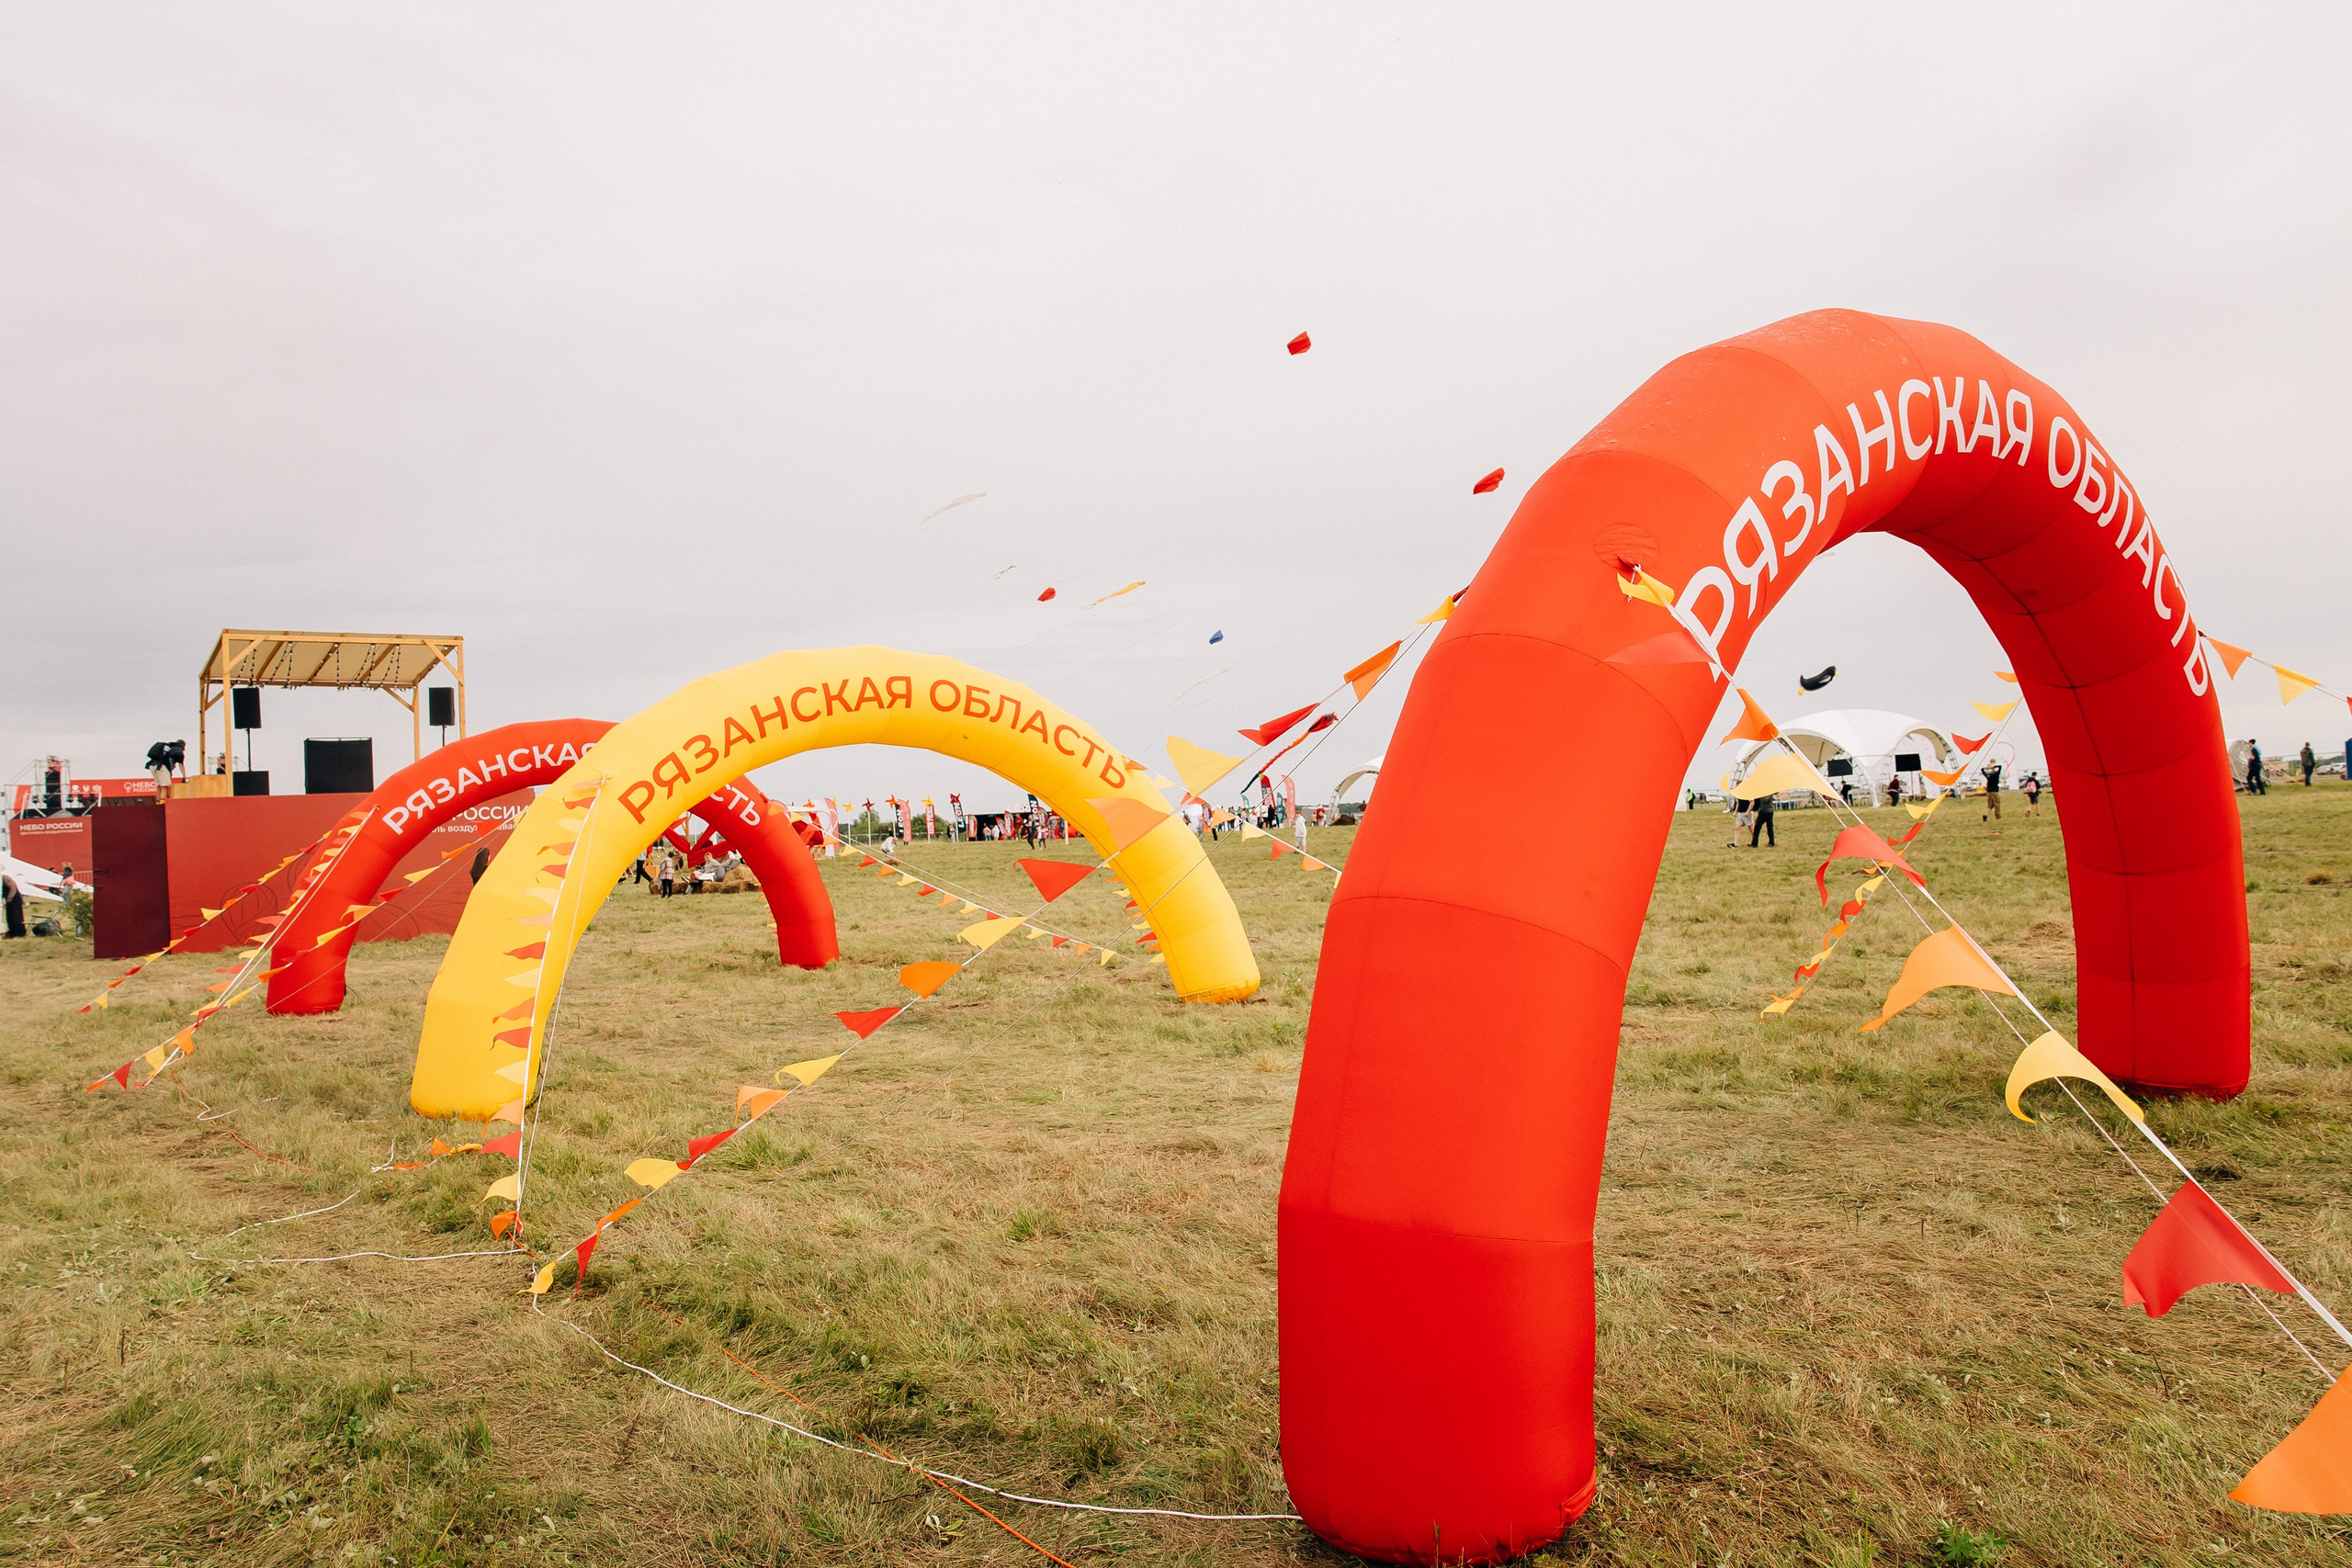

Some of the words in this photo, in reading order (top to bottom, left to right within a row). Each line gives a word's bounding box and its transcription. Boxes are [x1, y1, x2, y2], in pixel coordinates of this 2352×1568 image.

[1674, 376, 2034, 682] РЯЗАНСКАЯ
[2048, 416, 2209, 697] ОБЛАСТЬ
[20, 823, 45, 831] НЕБО
[46, 821, 83, 830] РОССИИ
[617, 676, 912, 826] РЯЗАНСКАЯ
[929, 680, 1125, 789] ОБЛАСТЬ
